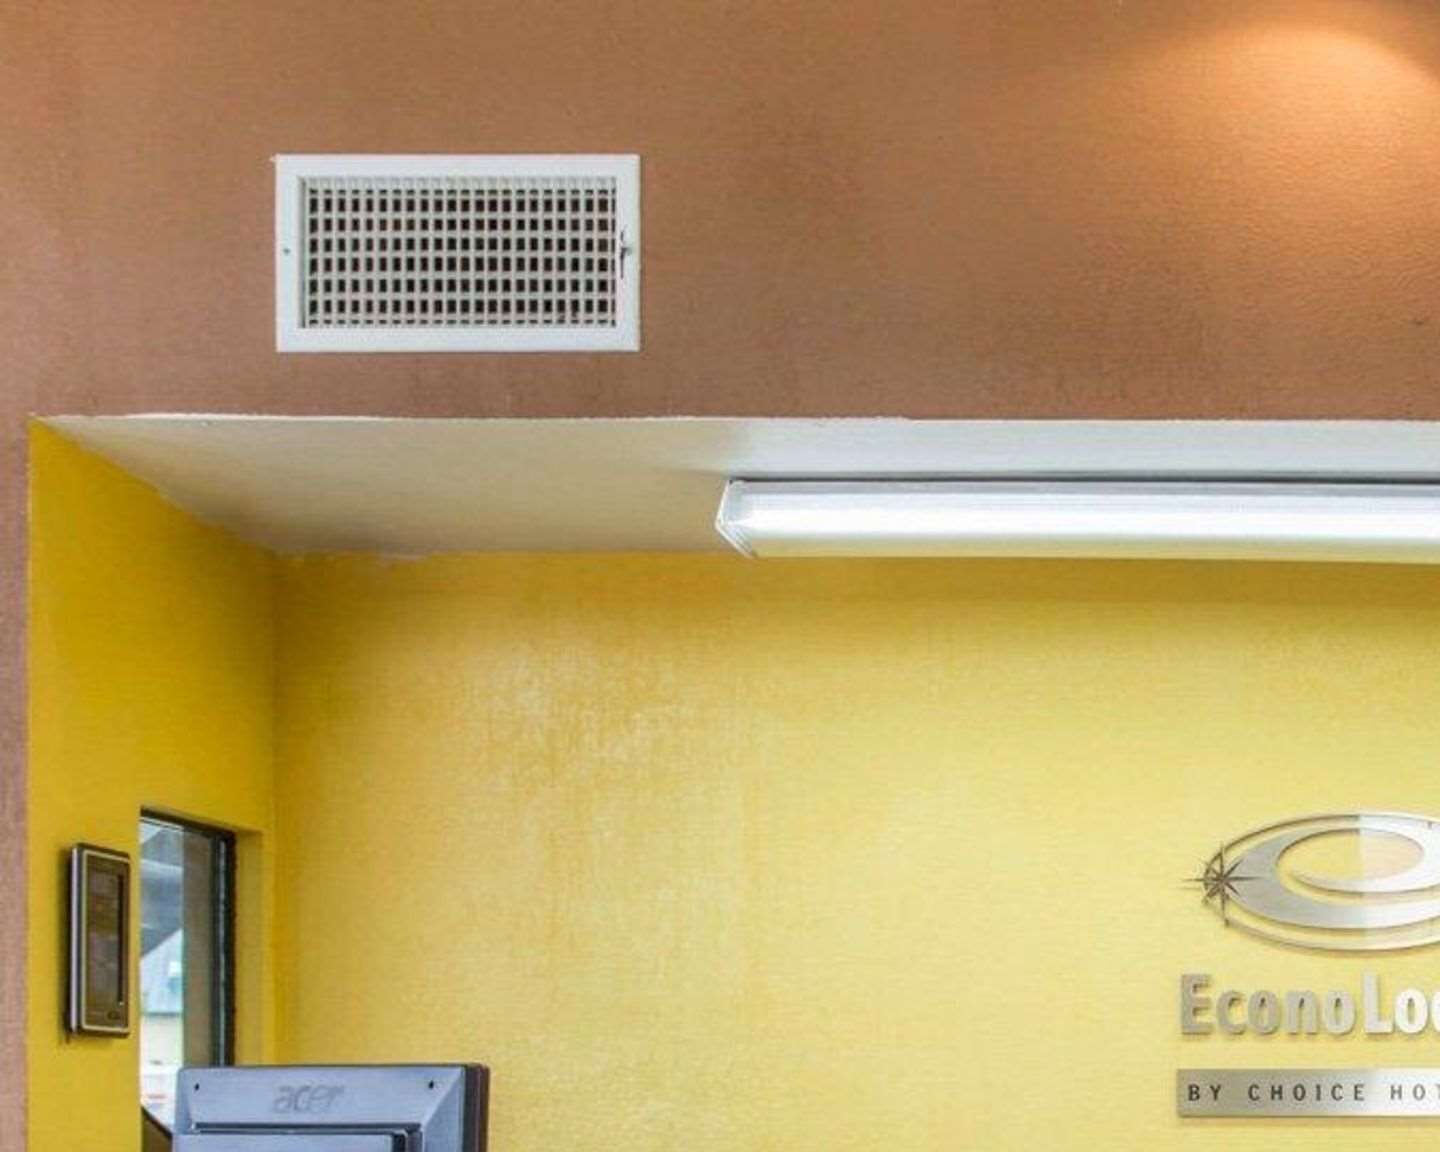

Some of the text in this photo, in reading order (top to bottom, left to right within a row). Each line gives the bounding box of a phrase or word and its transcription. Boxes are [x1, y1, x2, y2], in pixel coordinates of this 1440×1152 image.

[272, 1085, 345, 1113] acer
[1187, 1083, 1223, 1101] BY
[1247, 1083, 1366, 1101] CHOICE
